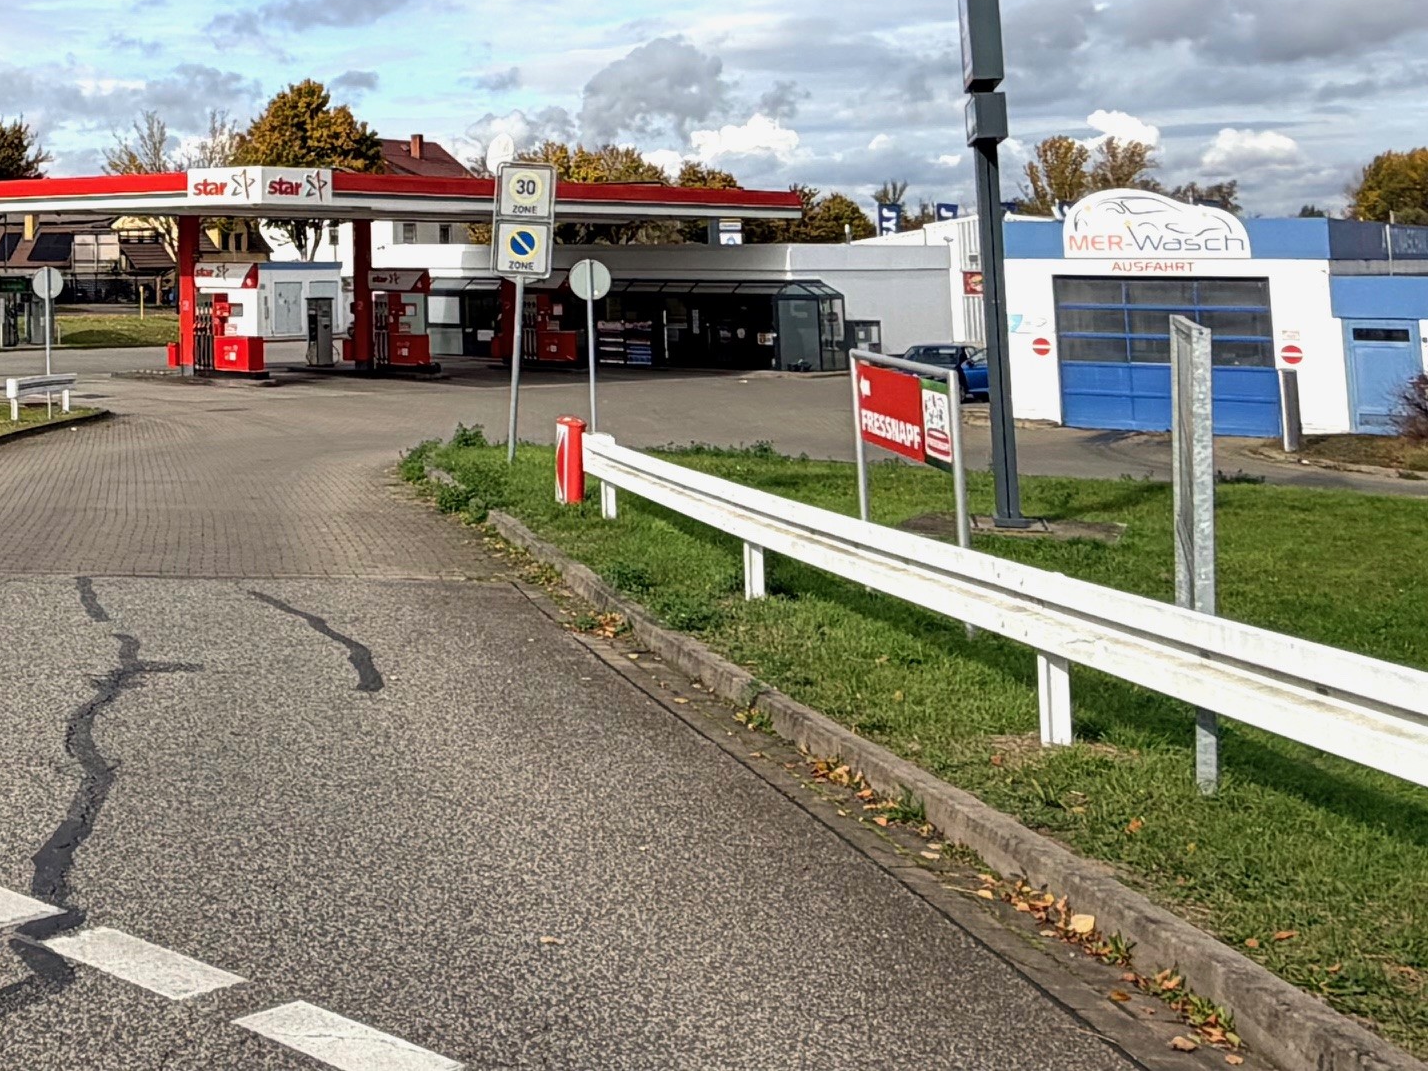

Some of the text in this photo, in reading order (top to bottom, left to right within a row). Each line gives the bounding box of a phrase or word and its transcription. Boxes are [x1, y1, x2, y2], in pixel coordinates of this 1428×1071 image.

[193, 178, 227, 196] star
[267, 177, 302, 196] star
[516, 180, 536, 195] 30
[512, 205, 537, 215] ZONE
[1069, 227, 1245, 251] MER-Wasch
[508, 261, 534, 271] ZONE
[1112, 262, 1195, 272] AUSFAHRT
[861, 409, 922, 449] FRESSNAPF
